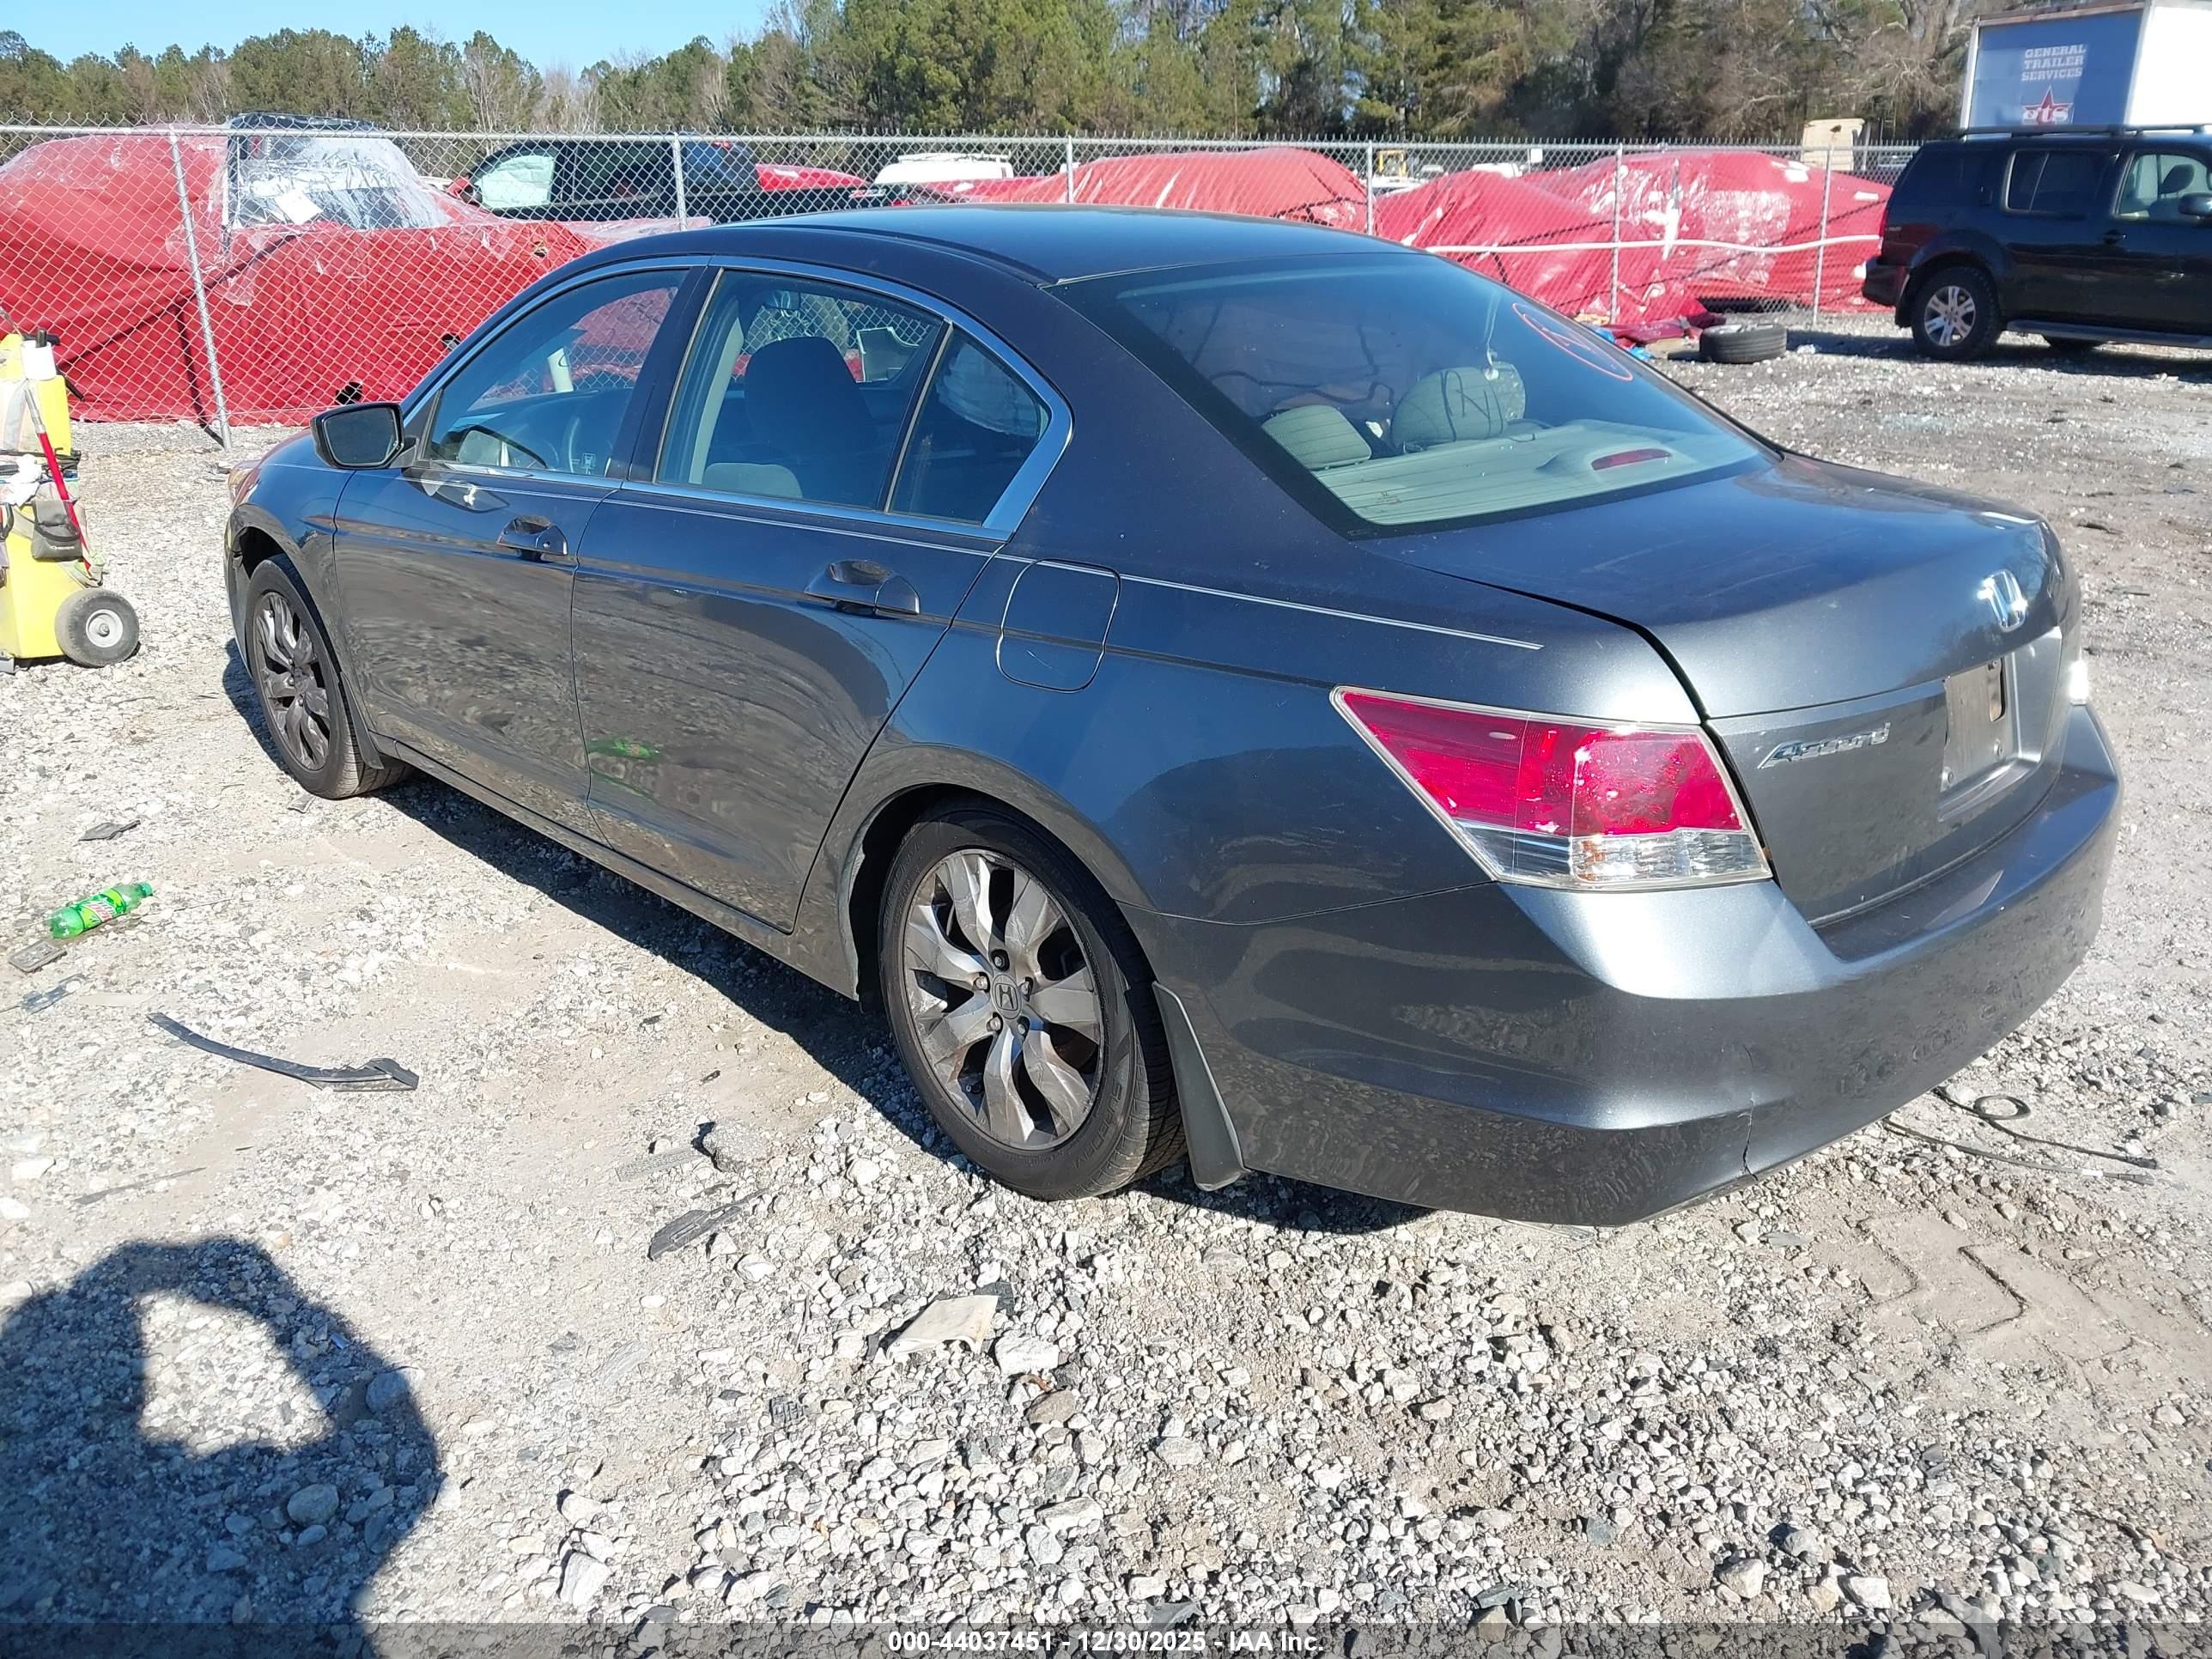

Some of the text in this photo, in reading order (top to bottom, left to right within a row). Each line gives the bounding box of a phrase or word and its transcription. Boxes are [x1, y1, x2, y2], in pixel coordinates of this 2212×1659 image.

[2025, 44, 2087, 58] GENERAL
[2024, 54, 2084, 69] TRAILER
[2021, 67, 2082, 82] SERVICES
[1757, 722, 1892, 770] Accord
